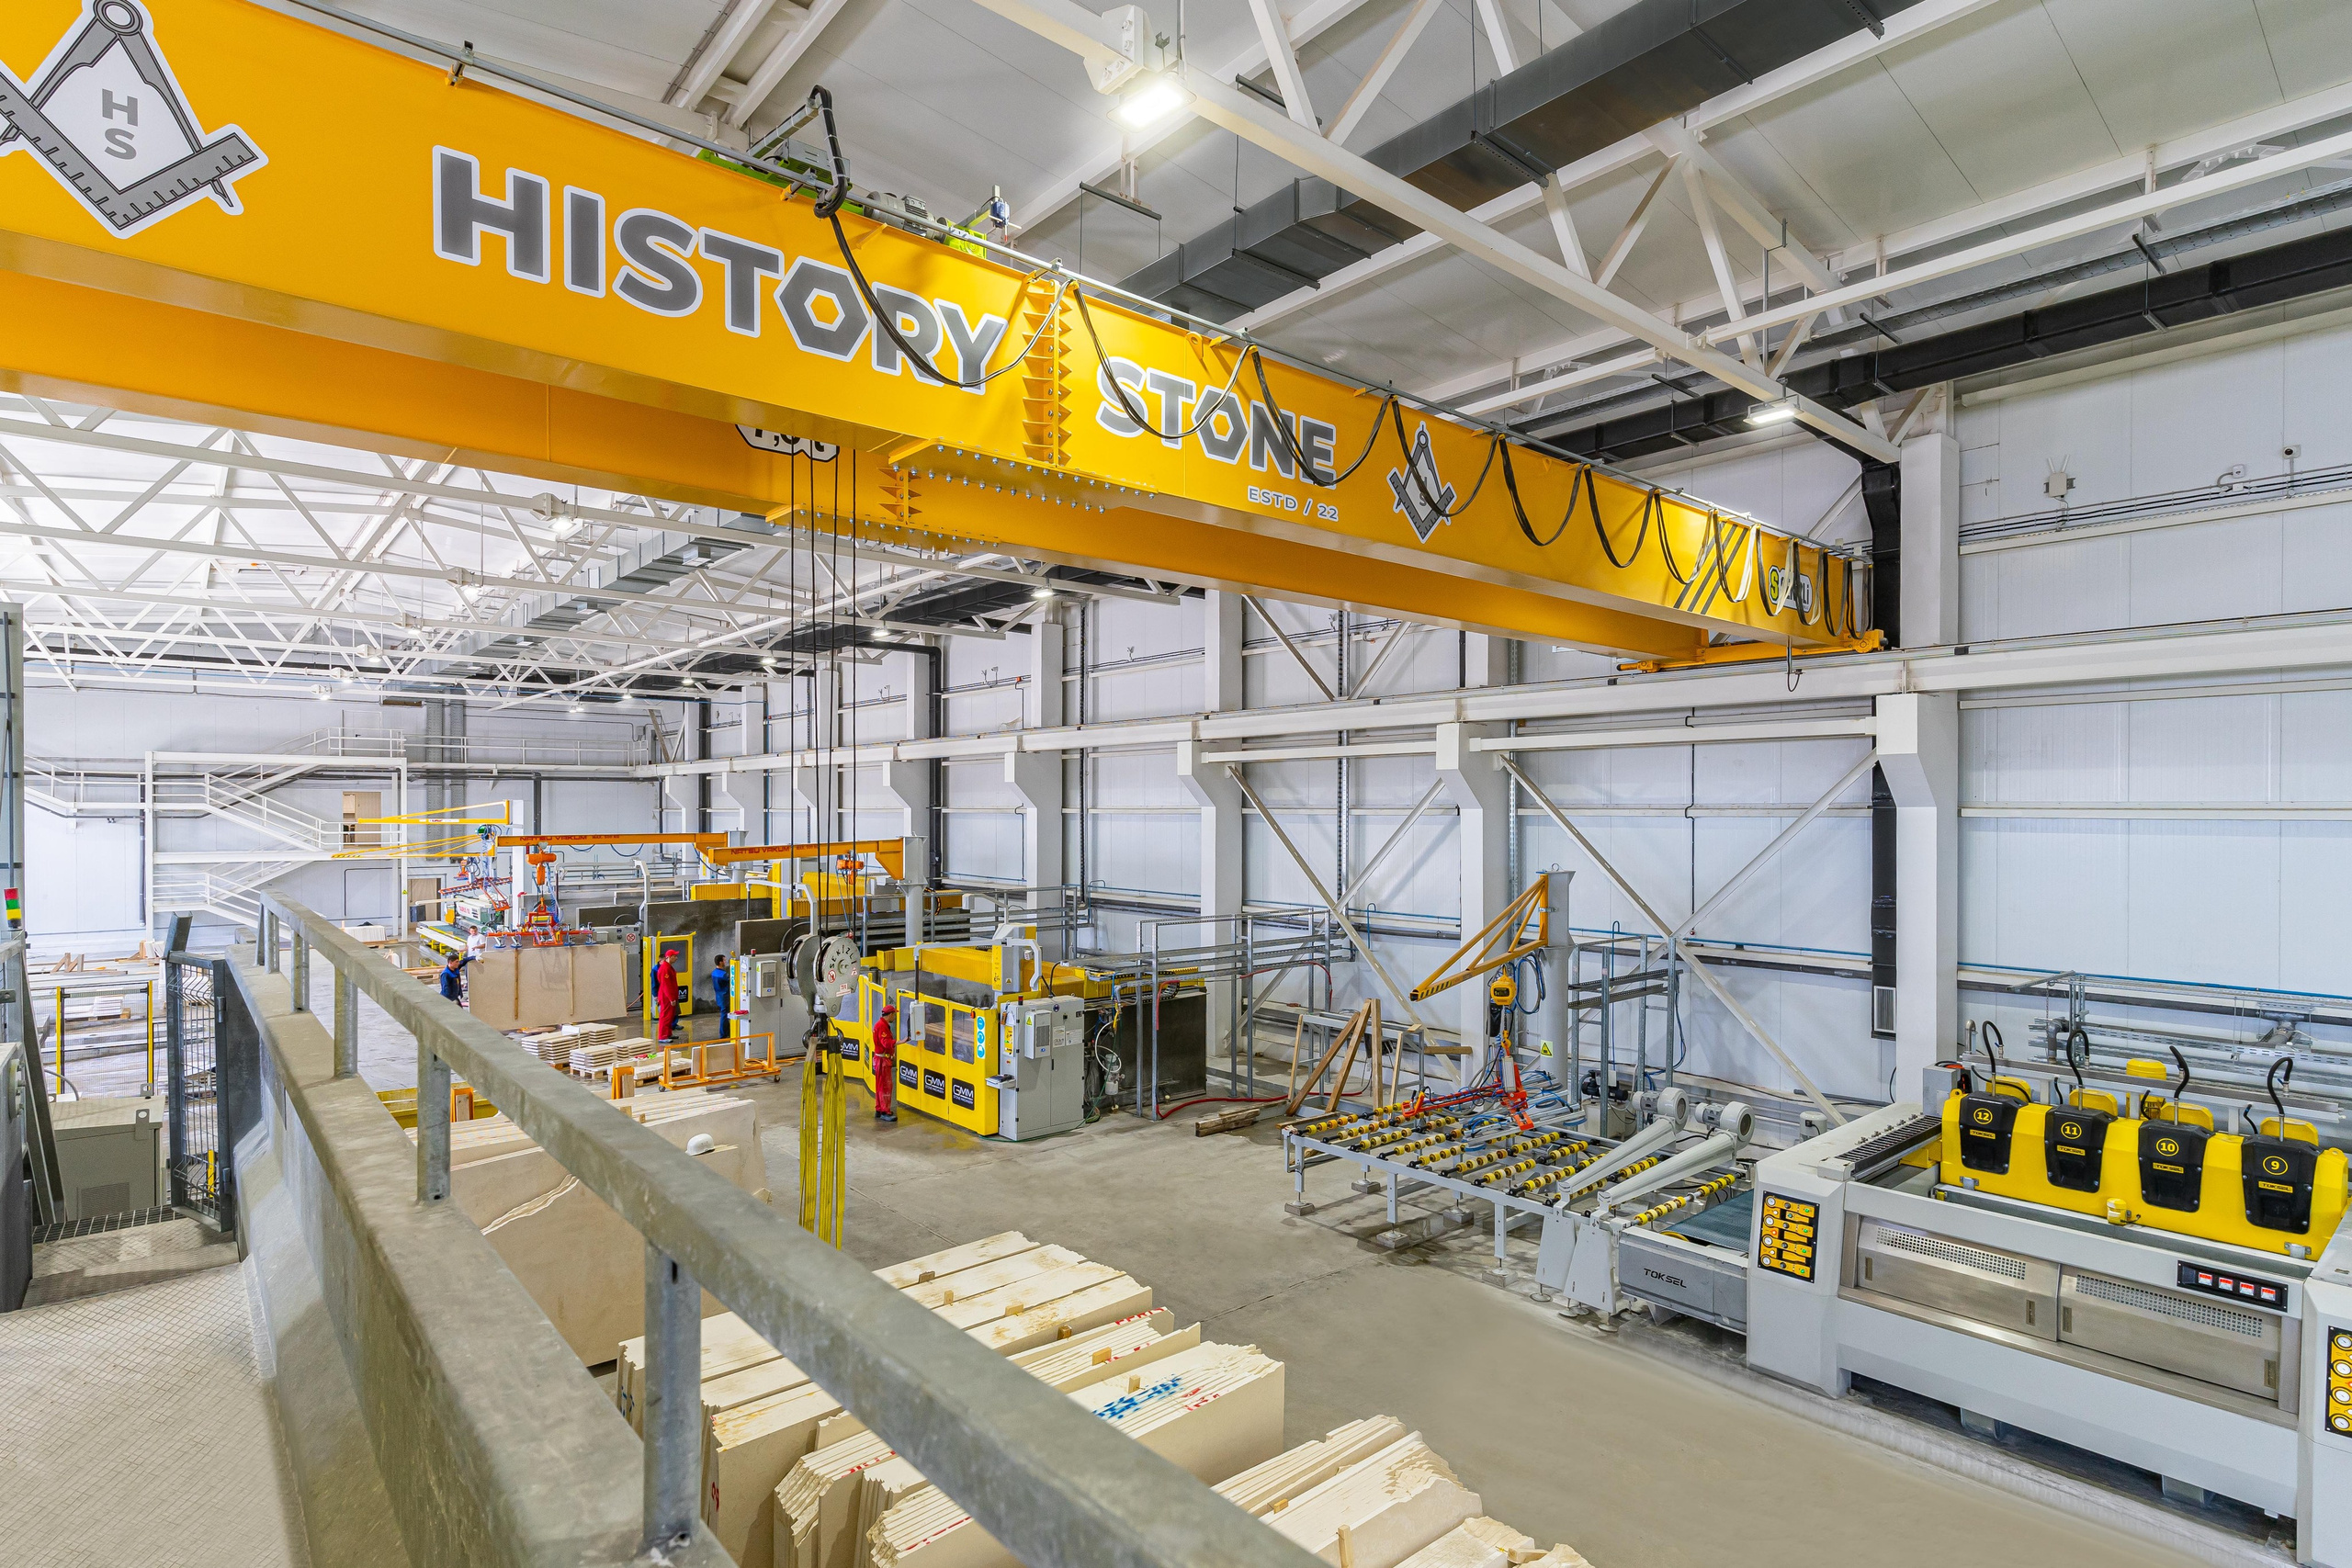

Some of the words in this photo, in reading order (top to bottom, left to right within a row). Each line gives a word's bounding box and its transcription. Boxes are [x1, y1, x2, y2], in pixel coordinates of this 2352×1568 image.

[102, 88, 139, 127] H
[104, 128, 137, 160] S
[434, 147, 1008, 395] HISTORY
[1096, 357, 1336, 489] STONE
[1248, 485, 1298, 512] ESTD
[1317, 504, 1340, 522] 22
[900, 1066, 918, 1078] GMM
[925, 1075, 945, 1088] GMM
[953, 1084, 974, 1099] GMM
[1977, 1111, 1990, 1122] 12
[2064, 1125, 2078, 1135] 11
[2160, 1142, 2176, 1152] 10
[2270, 1160, 2280, 1170] 9
[1644, 1268, 1687, 1288] TOKSEL
